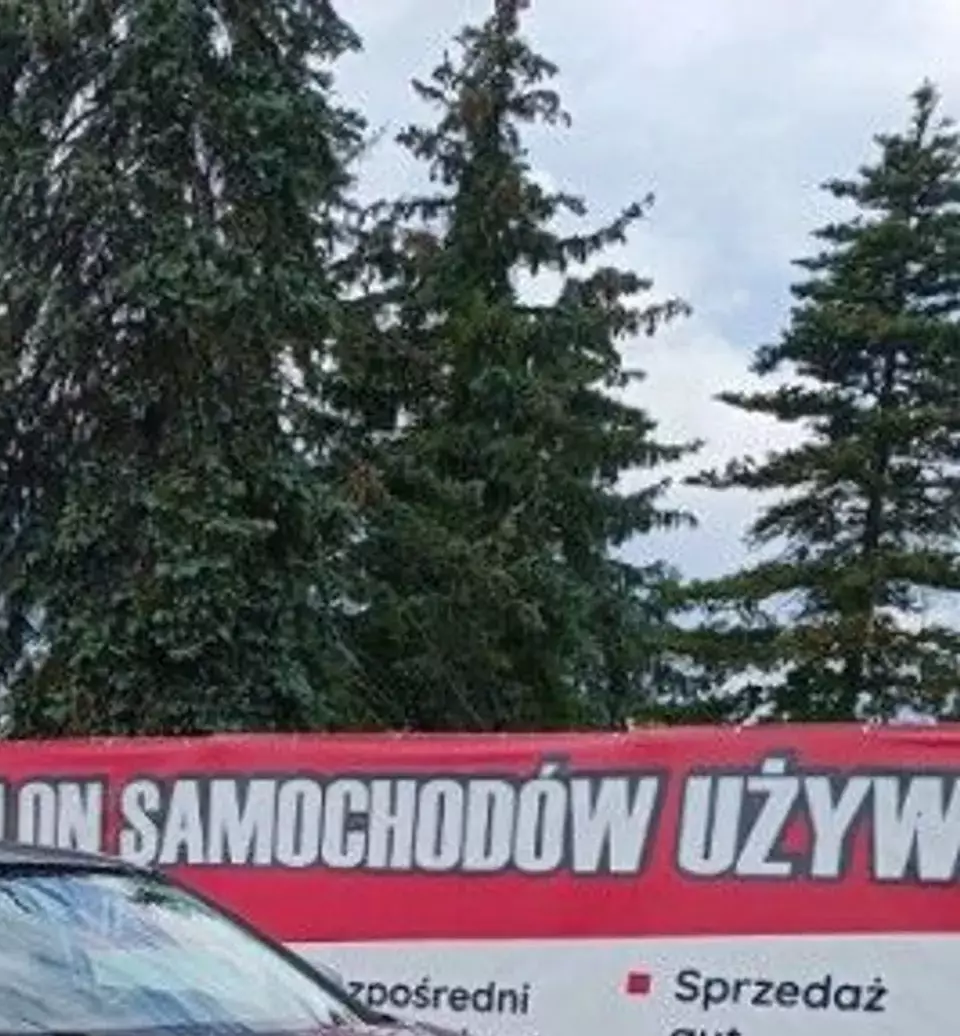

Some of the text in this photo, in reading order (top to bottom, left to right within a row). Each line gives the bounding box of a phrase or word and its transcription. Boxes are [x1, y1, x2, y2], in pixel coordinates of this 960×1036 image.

[119, 763, 659, 874] SAMOCHODÓW
[677, 757, 960, 881] UŻYW
[674, 968, 889, 1013] Sprzedaż
